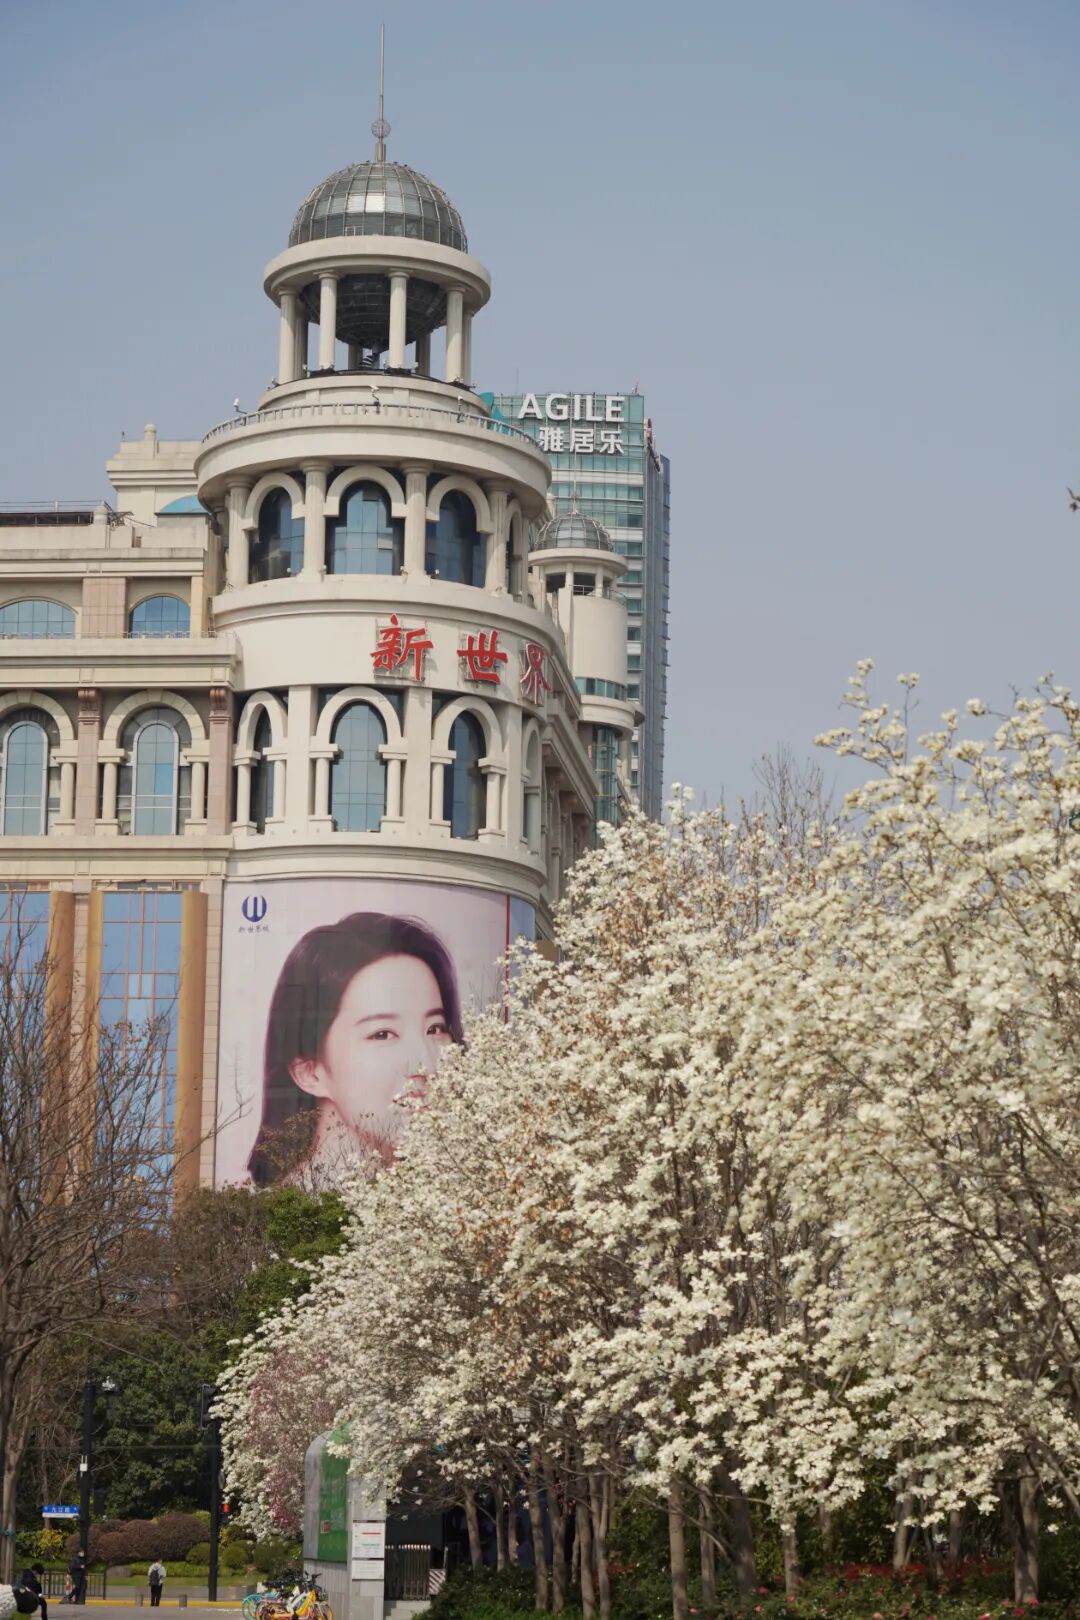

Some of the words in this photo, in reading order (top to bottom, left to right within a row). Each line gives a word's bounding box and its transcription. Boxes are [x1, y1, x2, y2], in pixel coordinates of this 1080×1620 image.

[517, 393, 625, 422] AGILE
[539, 427, 625, 454] 雅居乐
[370, 613, 553, 705] 新世界
